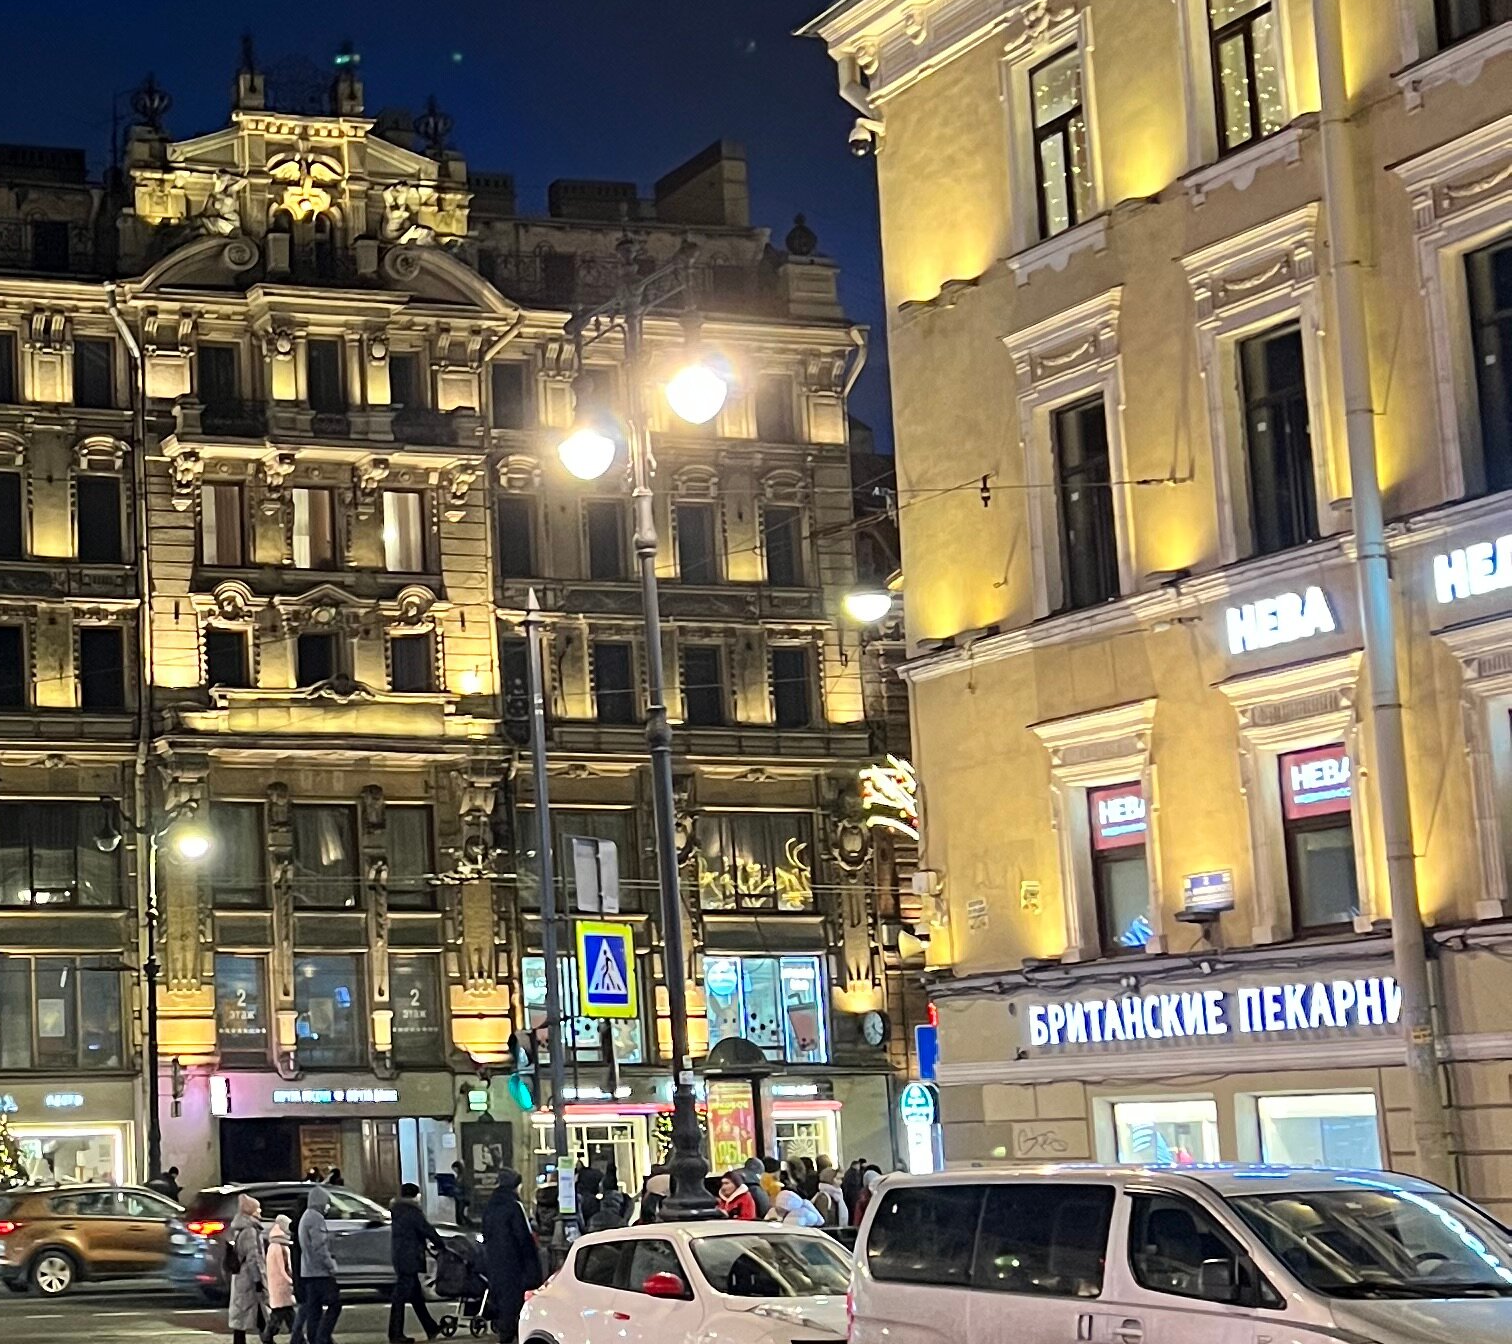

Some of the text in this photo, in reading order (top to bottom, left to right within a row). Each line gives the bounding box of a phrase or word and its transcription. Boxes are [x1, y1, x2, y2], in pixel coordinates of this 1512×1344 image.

[1226, 586, 1335, 654] НЕВА
[237, 988, 246, 1007] 2
[410, 988, 420, 1007] 2
[1028, 991, 1228, 1046] БРИТАНСКИЕ
